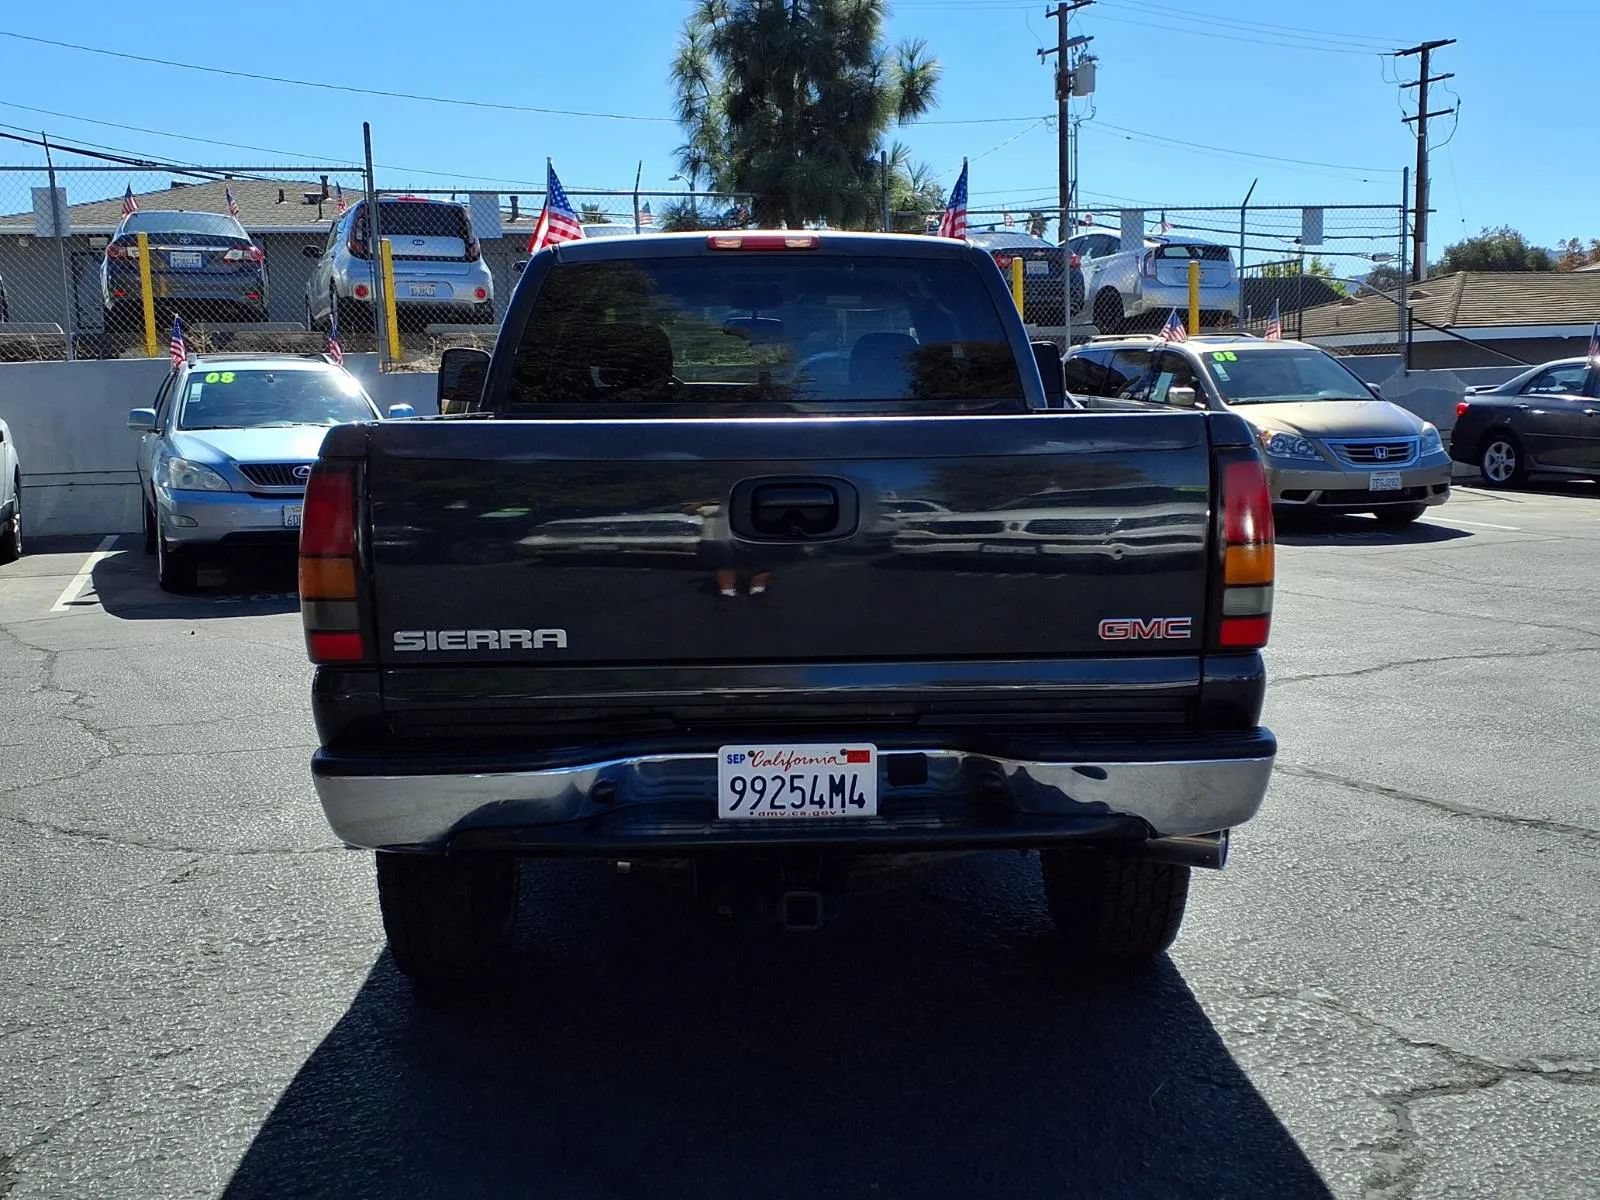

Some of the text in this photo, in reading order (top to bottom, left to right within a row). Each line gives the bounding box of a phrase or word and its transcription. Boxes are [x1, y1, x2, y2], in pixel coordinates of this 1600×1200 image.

[1212, 351, 1238, 361] 08
[205, 371, 236, 384] 08
[393, 628, 567, 651] SIERRA
[1098, 617, 1192, 640] GMC
[727, 754, 746, 764] SEP
[752, 750, 840, 772] California
[729, 774, 866, 811] 99254M4
